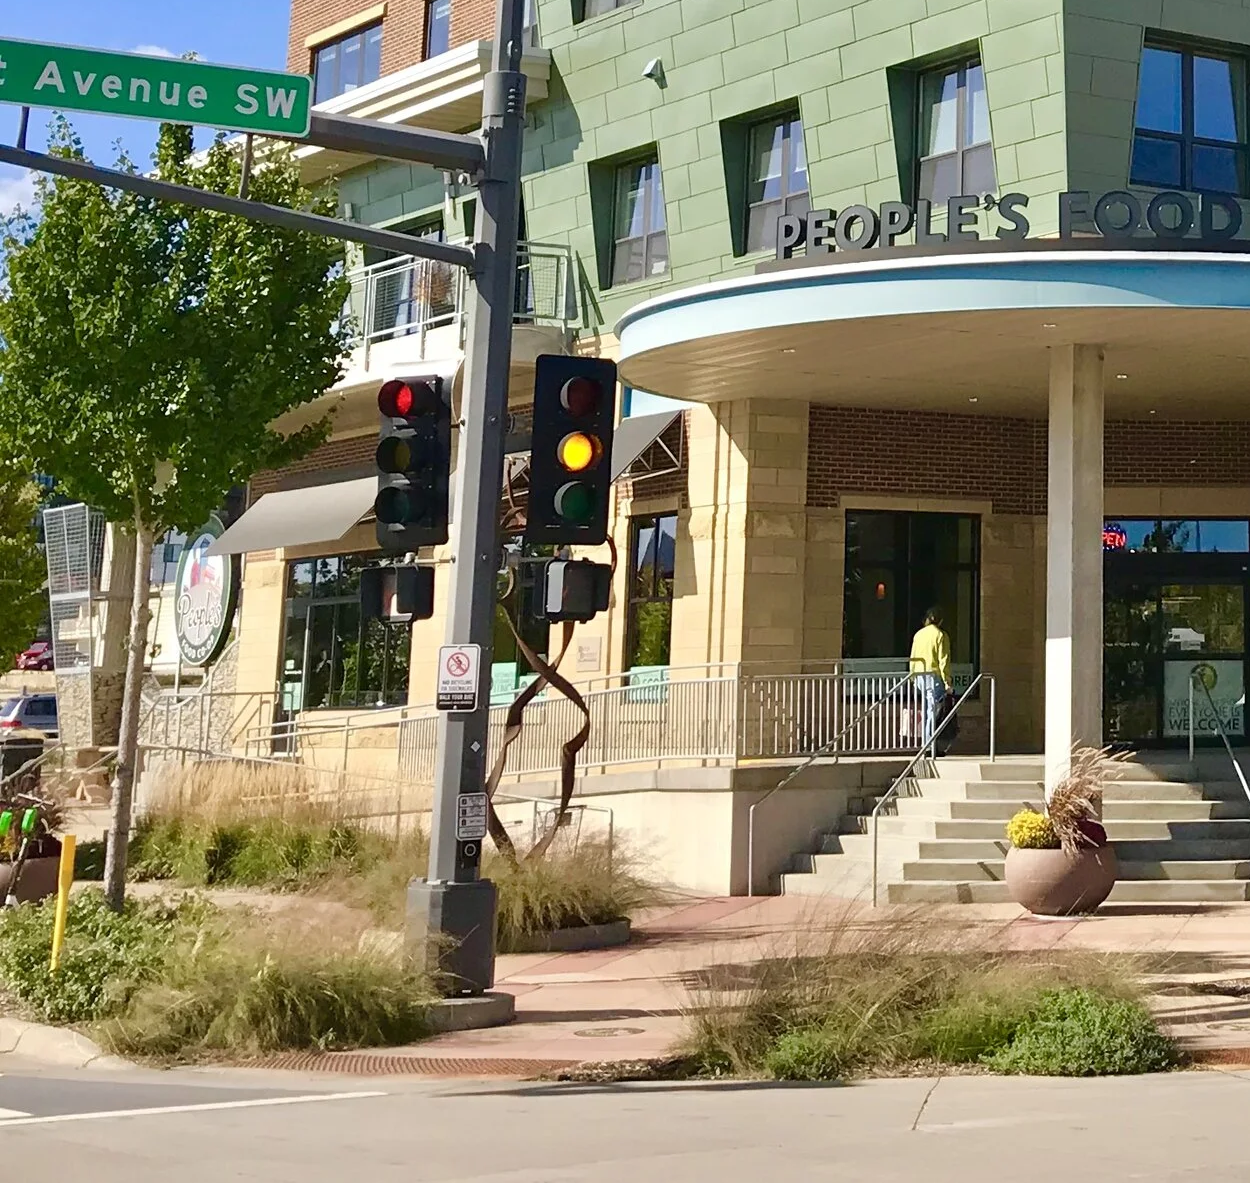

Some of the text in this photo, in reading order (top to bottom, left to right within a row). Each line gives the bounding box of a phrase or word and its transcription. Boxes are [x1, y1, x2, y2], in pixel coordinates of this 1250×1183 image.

[34, 60, 208, 109] Avenue
[234, 83, 298, 119] SW
[776, 193, 1030, 260] PEOPLE'S
[1058, 191, 1243, 241] FOOD
[1102, 532, 1126, 547] PEN
[1169, 719, 1240, 731] WELCOME
